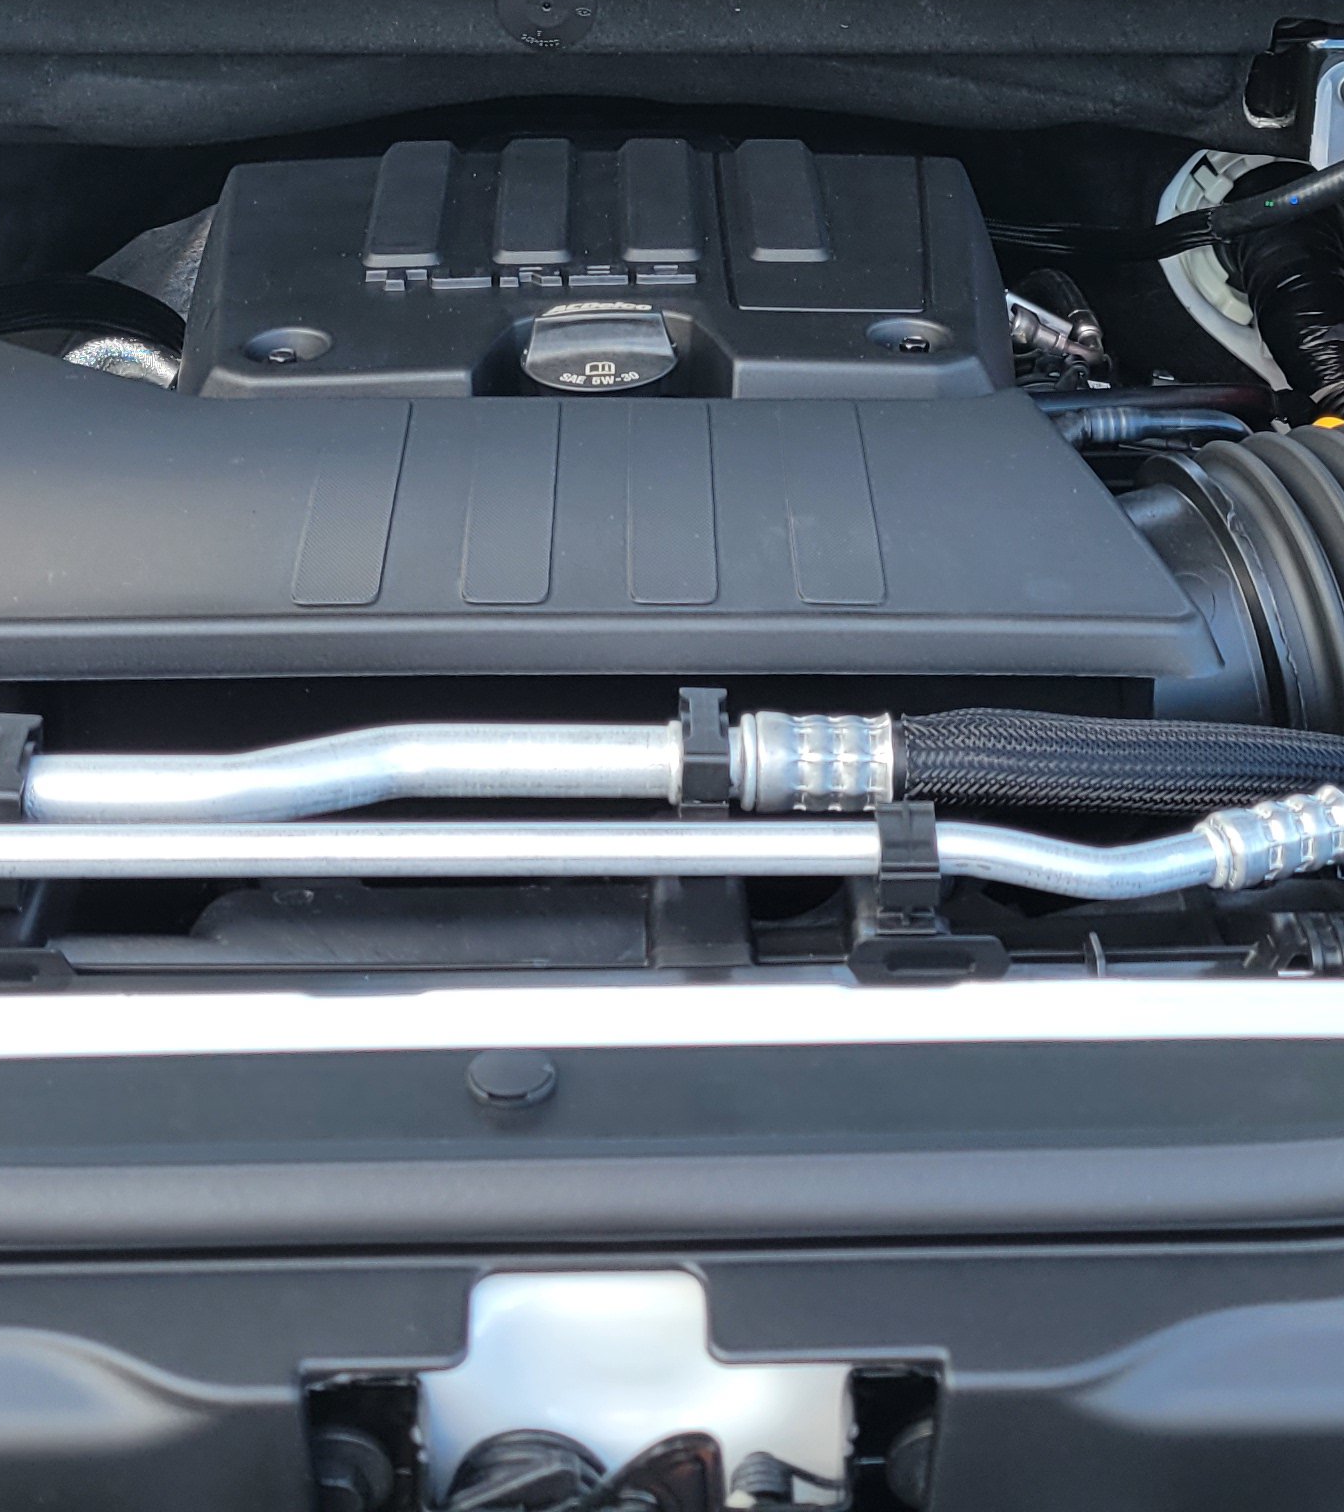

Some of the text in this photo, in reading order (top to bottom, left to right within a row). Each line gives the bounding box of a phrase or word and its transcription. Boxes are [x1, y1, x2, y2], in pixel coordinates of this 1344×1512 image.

[541, 301, 653, 317] ACDelco
[559, 371, 641, 386] SAE 5W-30
